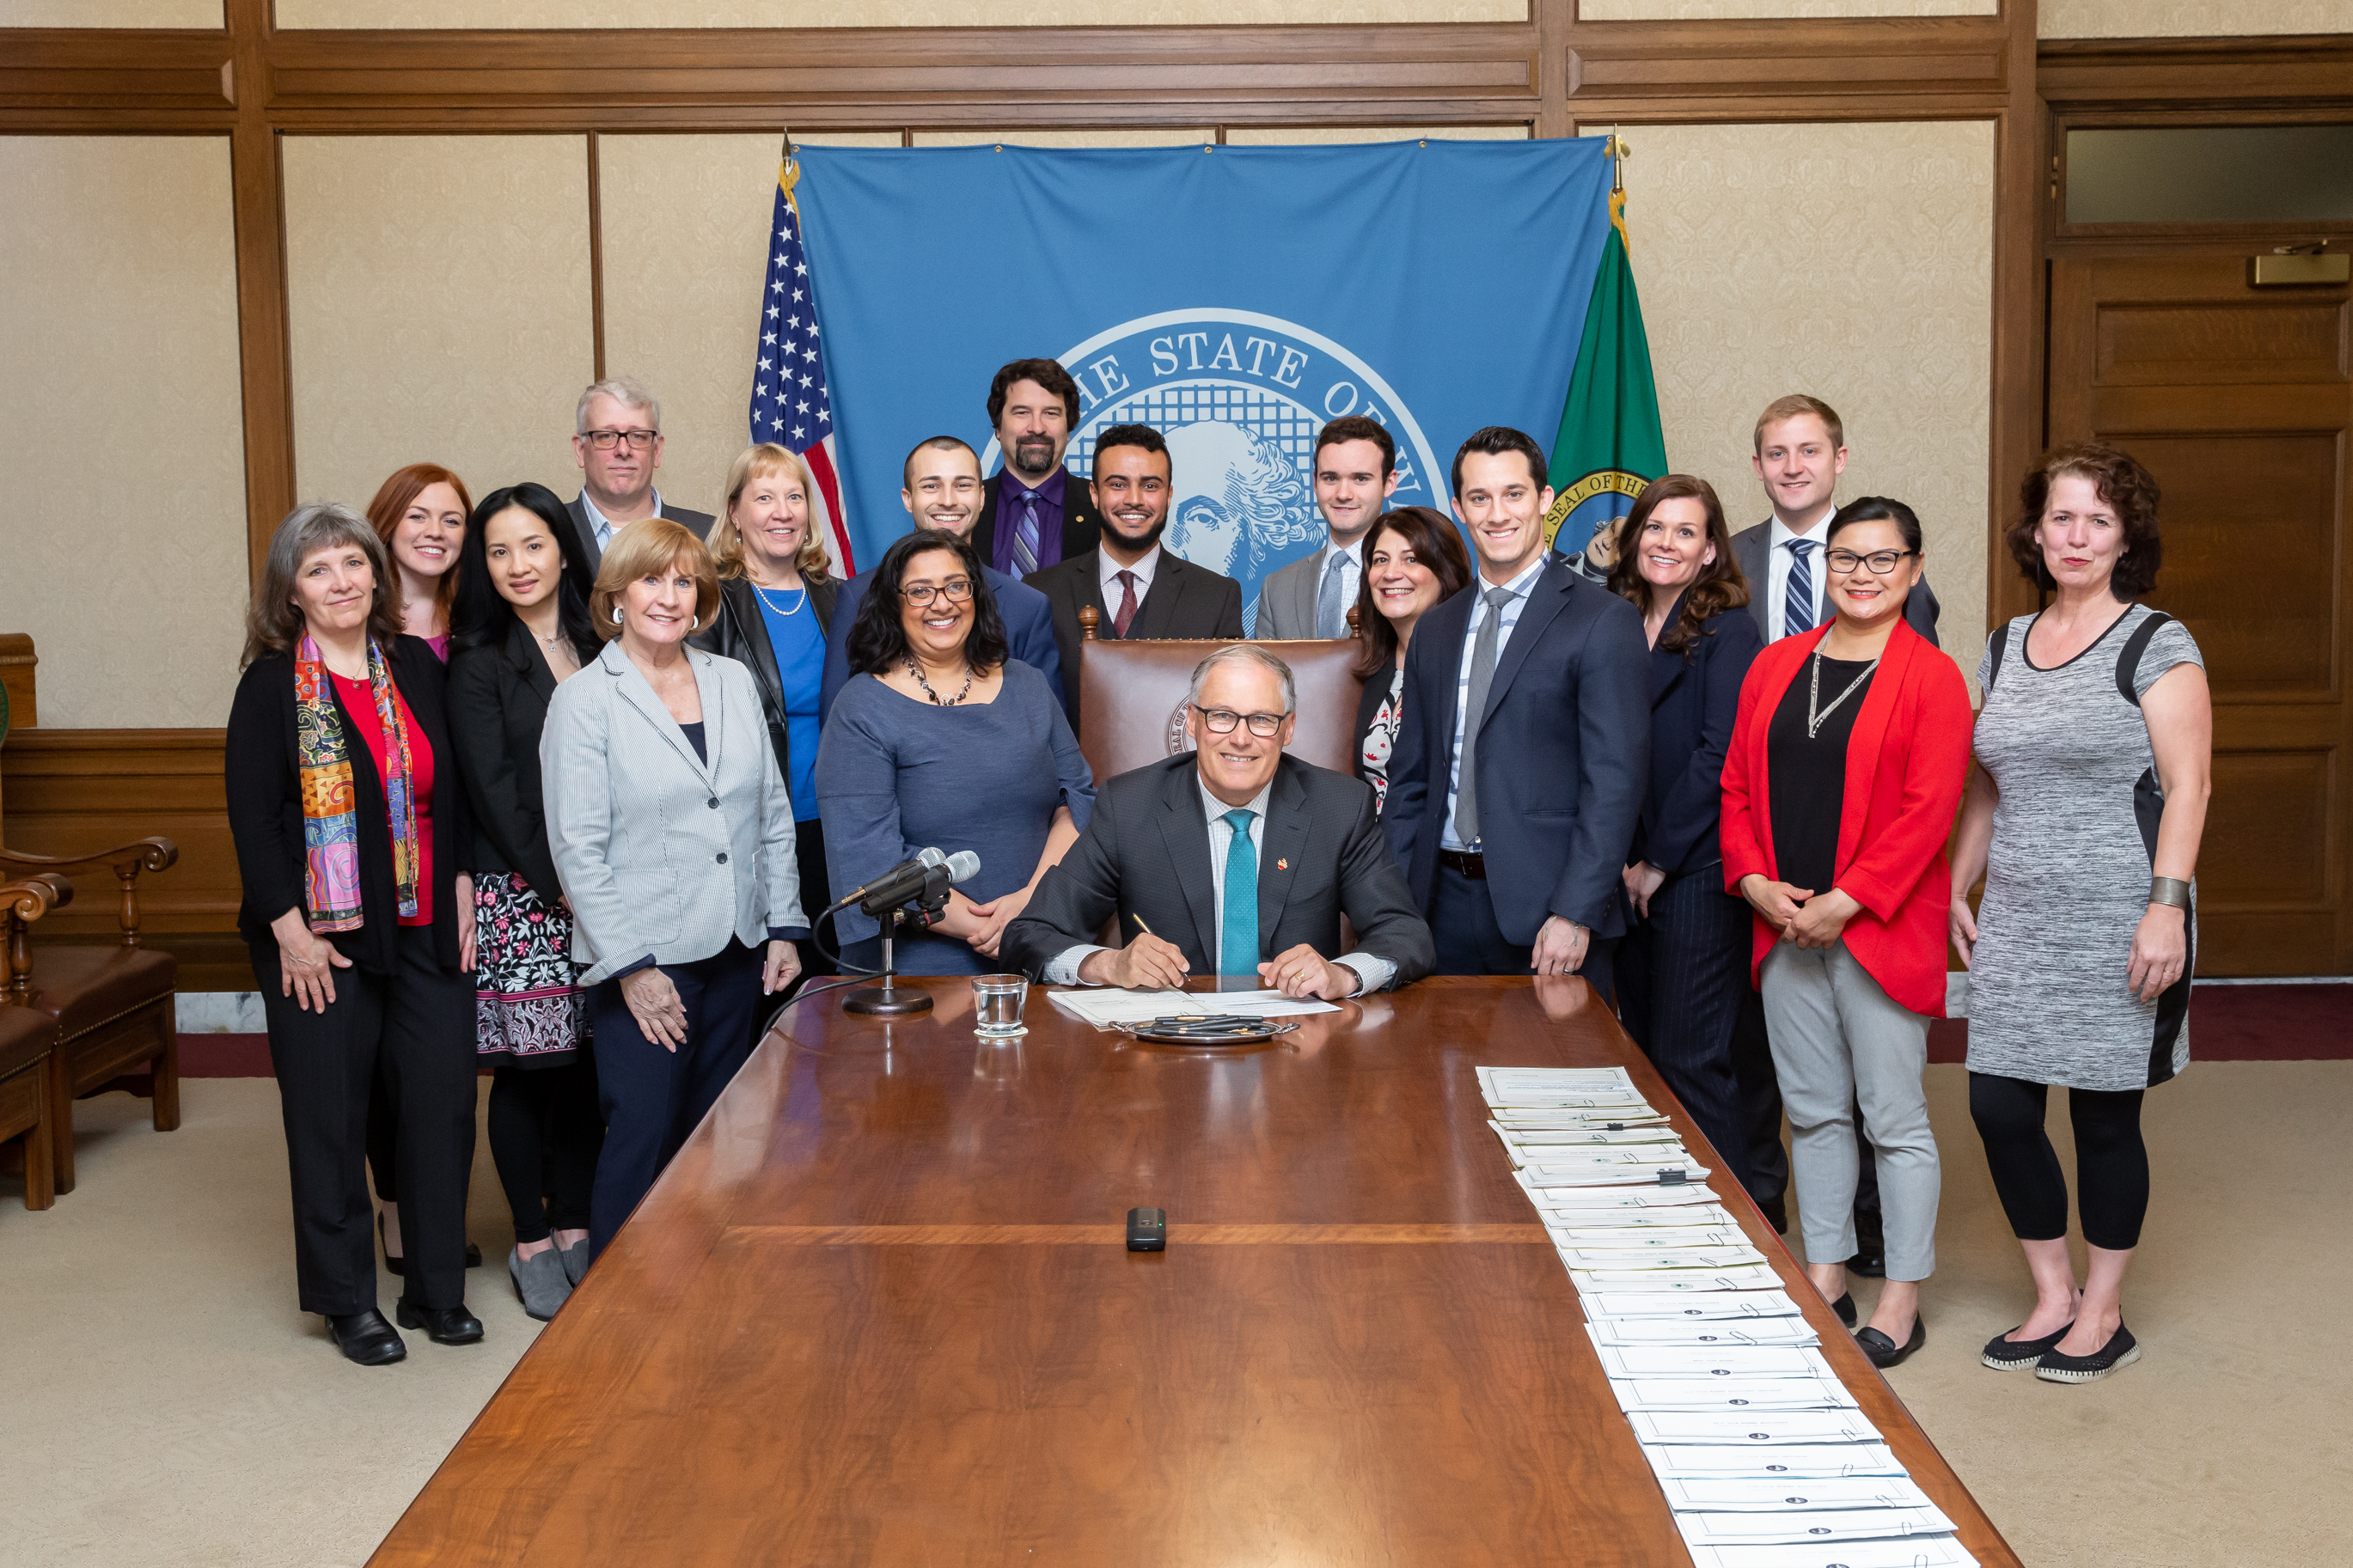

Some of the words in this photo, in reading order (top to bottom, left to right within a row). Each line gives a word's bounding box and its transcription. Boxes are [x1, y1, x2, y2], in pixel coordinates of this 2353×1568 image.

[1073, 355, 1129, 418] HE
[1150, 333, 1308, 388] STATE
[1547, 487, 1585, 526] SEAL
[1590, 474, 1612, 491] OF
